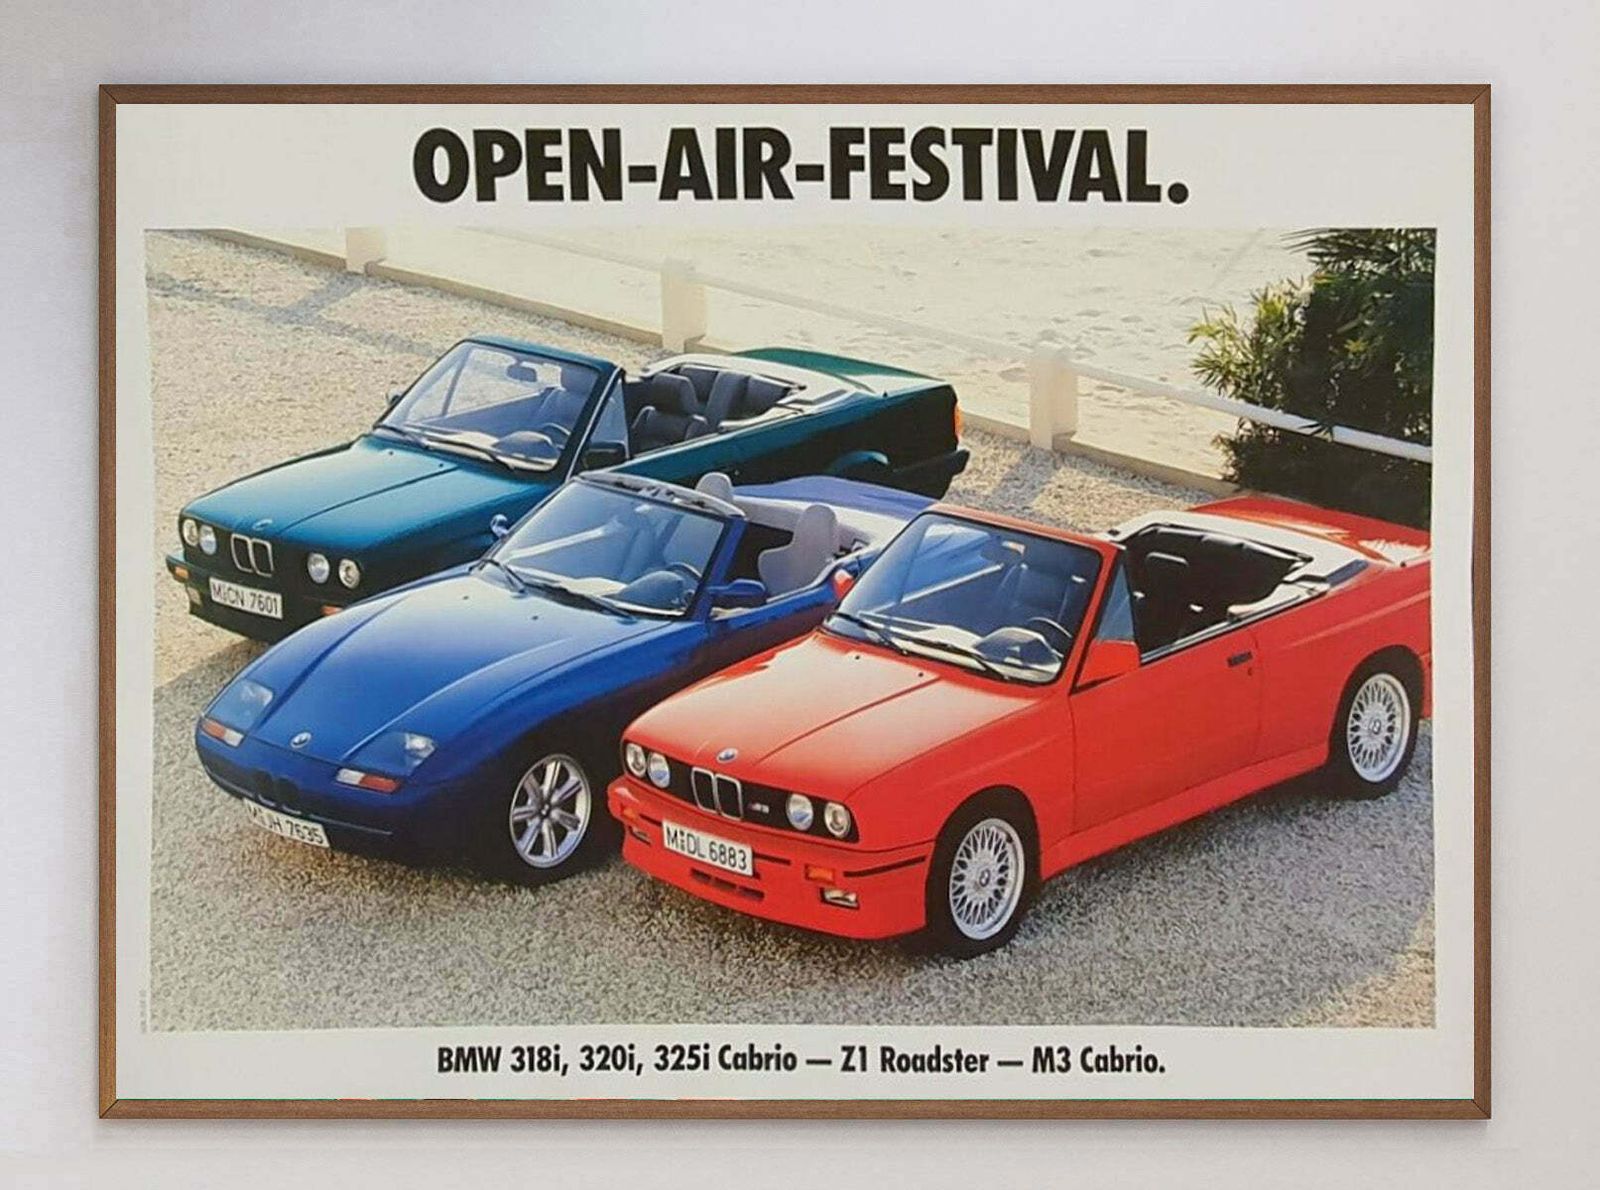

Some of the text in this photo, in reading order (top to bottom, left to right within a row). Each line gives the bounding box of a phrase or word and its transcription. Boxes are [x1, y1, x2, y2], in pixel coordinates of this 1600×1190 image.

[413, 126, 1189, 204] OPEN-AIR-FESTIVAL.
[249, 592, 278, 615] 7601
[708, 840, 747, 871] 6883
[437, 1046, 501, 1073] BMW
[510, 1043, 569, 1077] 318i,
[579, 1043, 644, 1077] 320i,
[653, 1042, 710, 1072] 325i
[718, 1042, 798, 1072] Cabrio
[840, 1045, 867, 1073] Z1
[880, 1044, 990, 1074] Roadster
[1032, 1046, 1072, 1074] M3
[1080, 1044, 1166, 1074] Cabrio.
